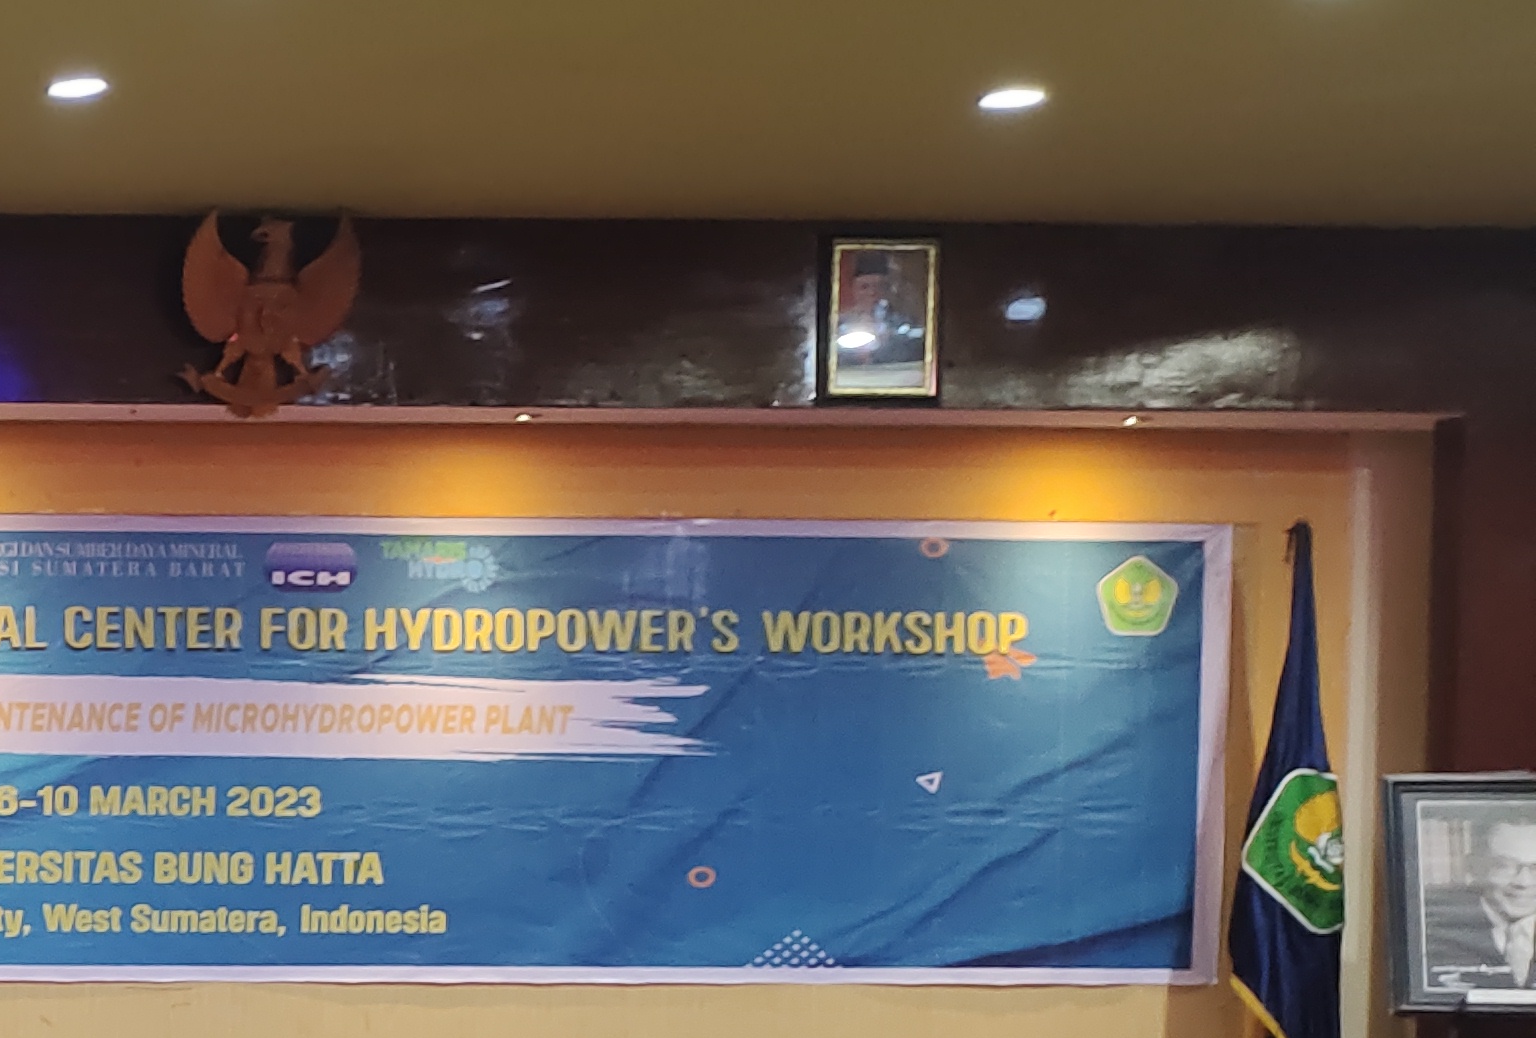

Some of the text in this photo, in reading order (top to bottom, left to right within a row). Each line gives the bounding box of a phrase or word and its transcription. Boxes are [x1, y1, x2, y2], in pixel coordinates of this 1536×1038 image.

[31, 560, 156, 577] SUMATERA
[169, 561, 245, 577] BARAT
[271, 570, 351, 586] ICH
[64, 606, 242, 650] CENTER
[260, 607, 348, 651] FOR
[364, 607, 740, 653] HYDROPOWER'S
[762, 610, 1028, 655] WORKSHOP
[148, 702, 185, 733] OF
[192, 702, 474, 734] MICROHYDROPOWER
[483, 704, 574, 735] PLANT
[89, 785, 216, 817] MARCH
[226, 786, 322, 817] 2023
[154, 851, 254, 884] BUNG
[265, 851, 385, 885] HATTA
[42, 902, 122, 933] West
[130, 903, 286, 938] Sumatera,
[300, 903, 448, 934] Indonesia
